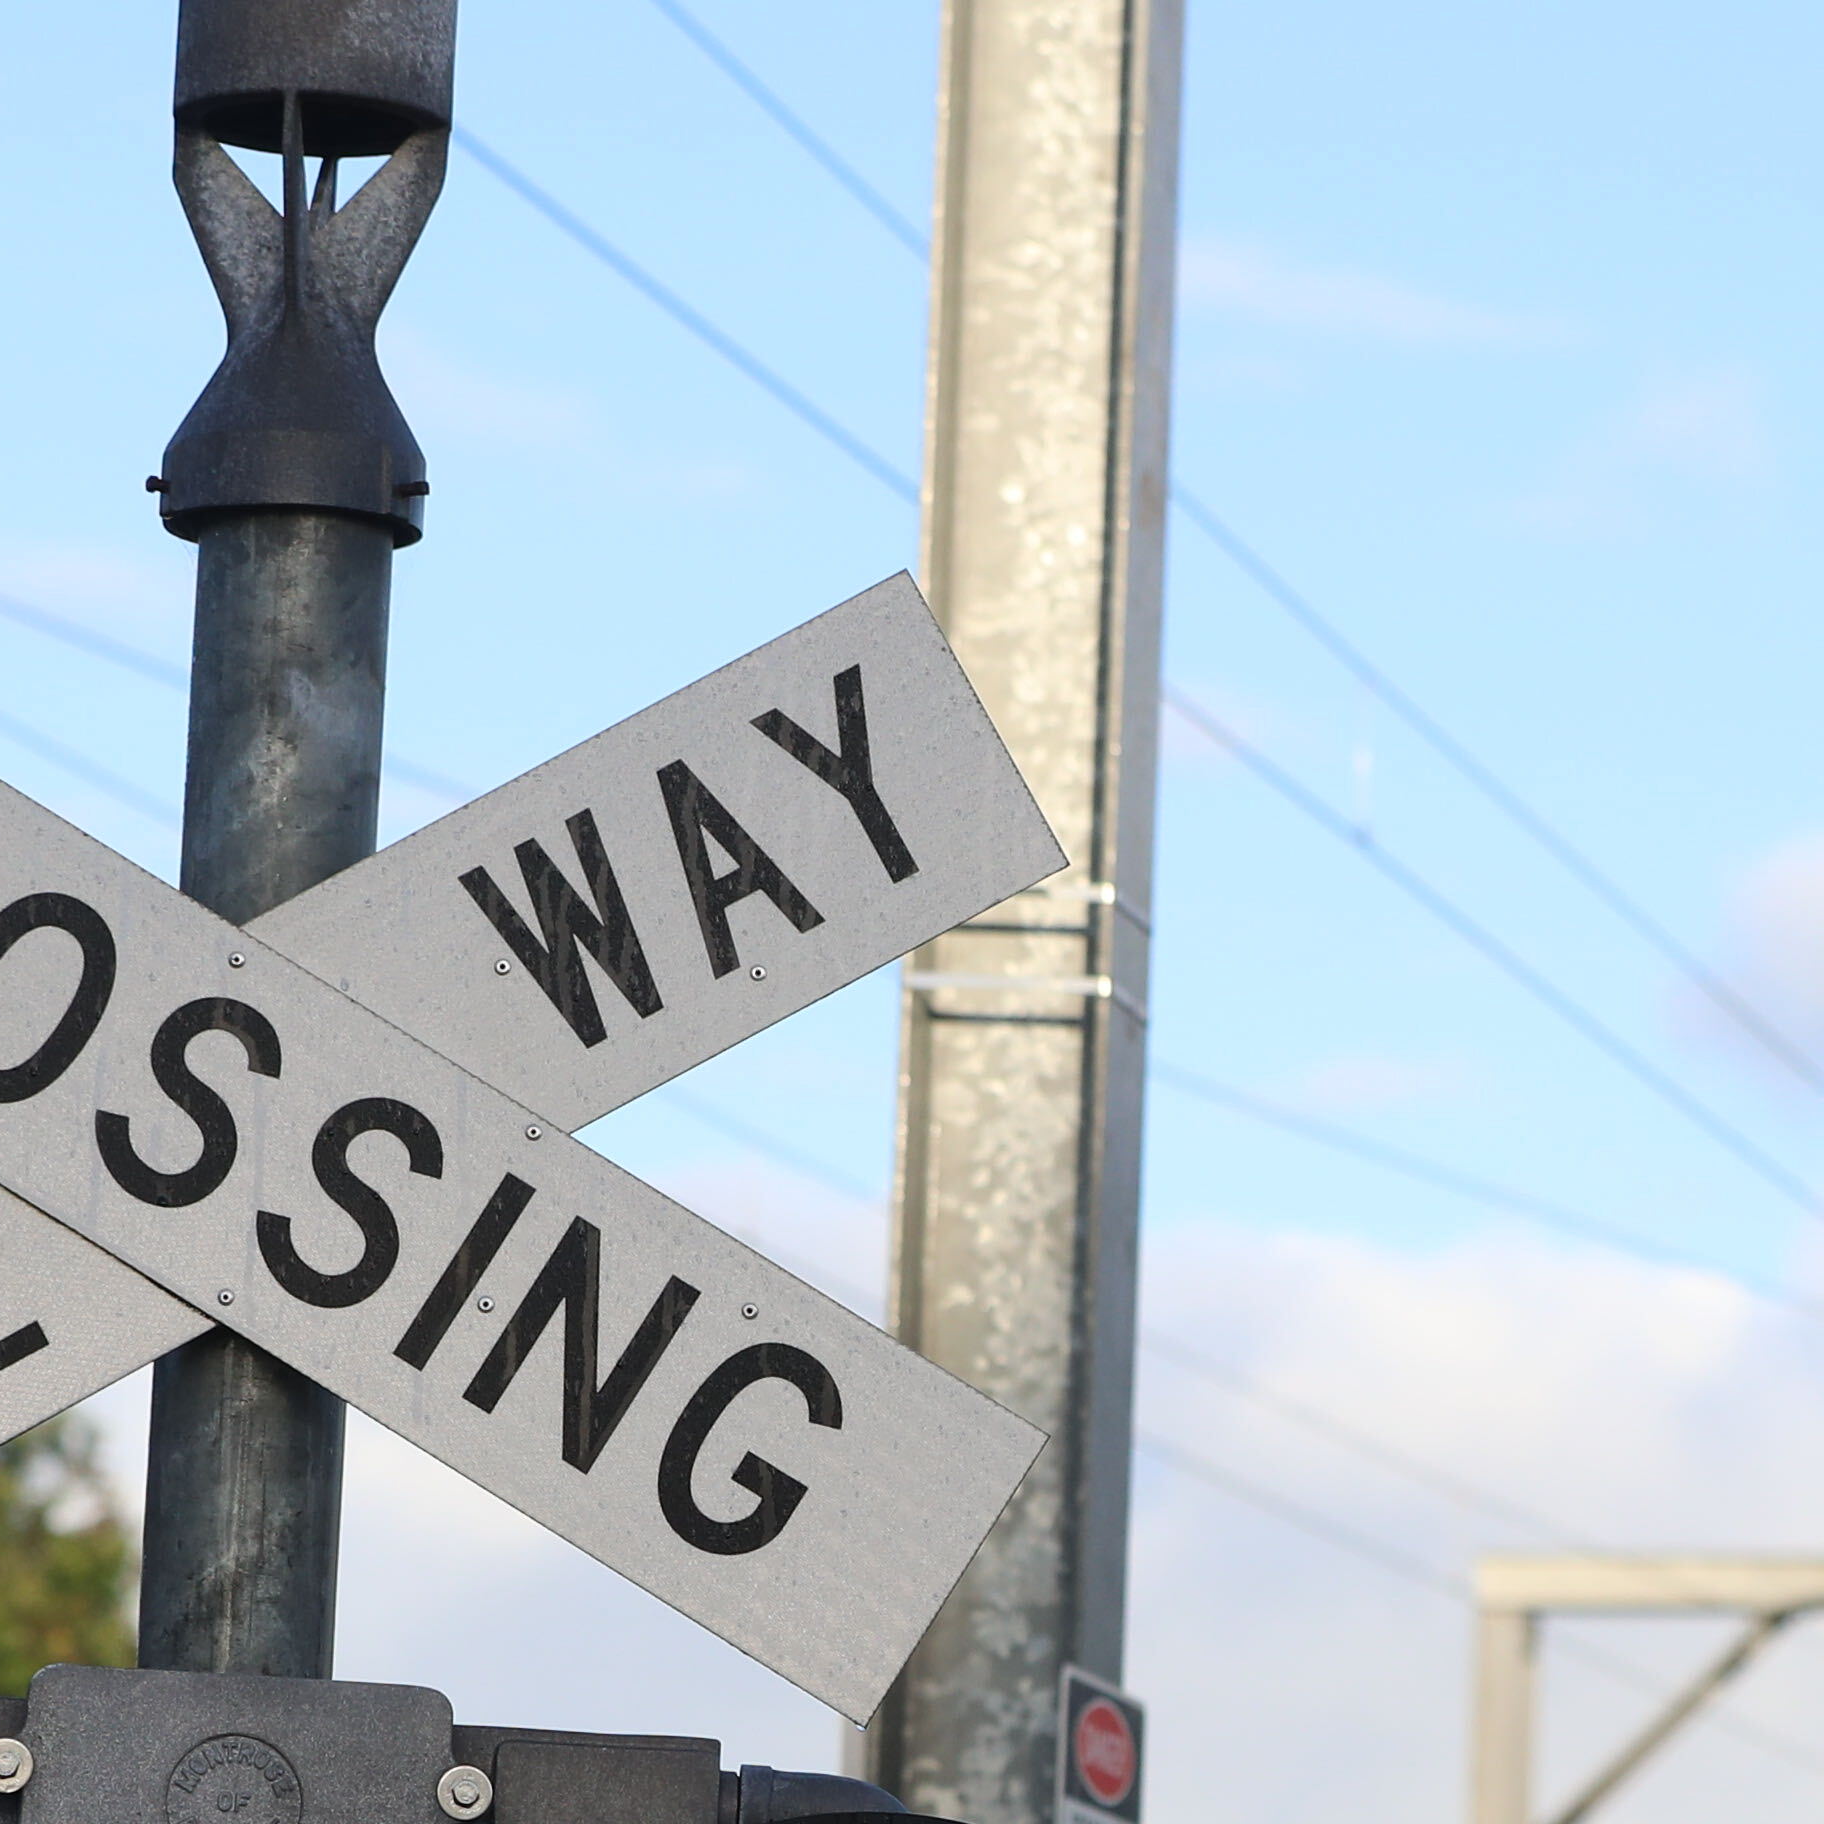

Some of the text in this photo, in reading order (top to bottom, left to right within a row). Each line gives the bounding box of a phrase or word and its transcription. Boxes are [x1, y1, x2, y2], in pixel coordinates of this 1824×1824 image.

[457, 664, 920, 1049] WAY
[174, 1742, 295, 1798] MONTROSE
[217, 1791, 251, 1813] OF
